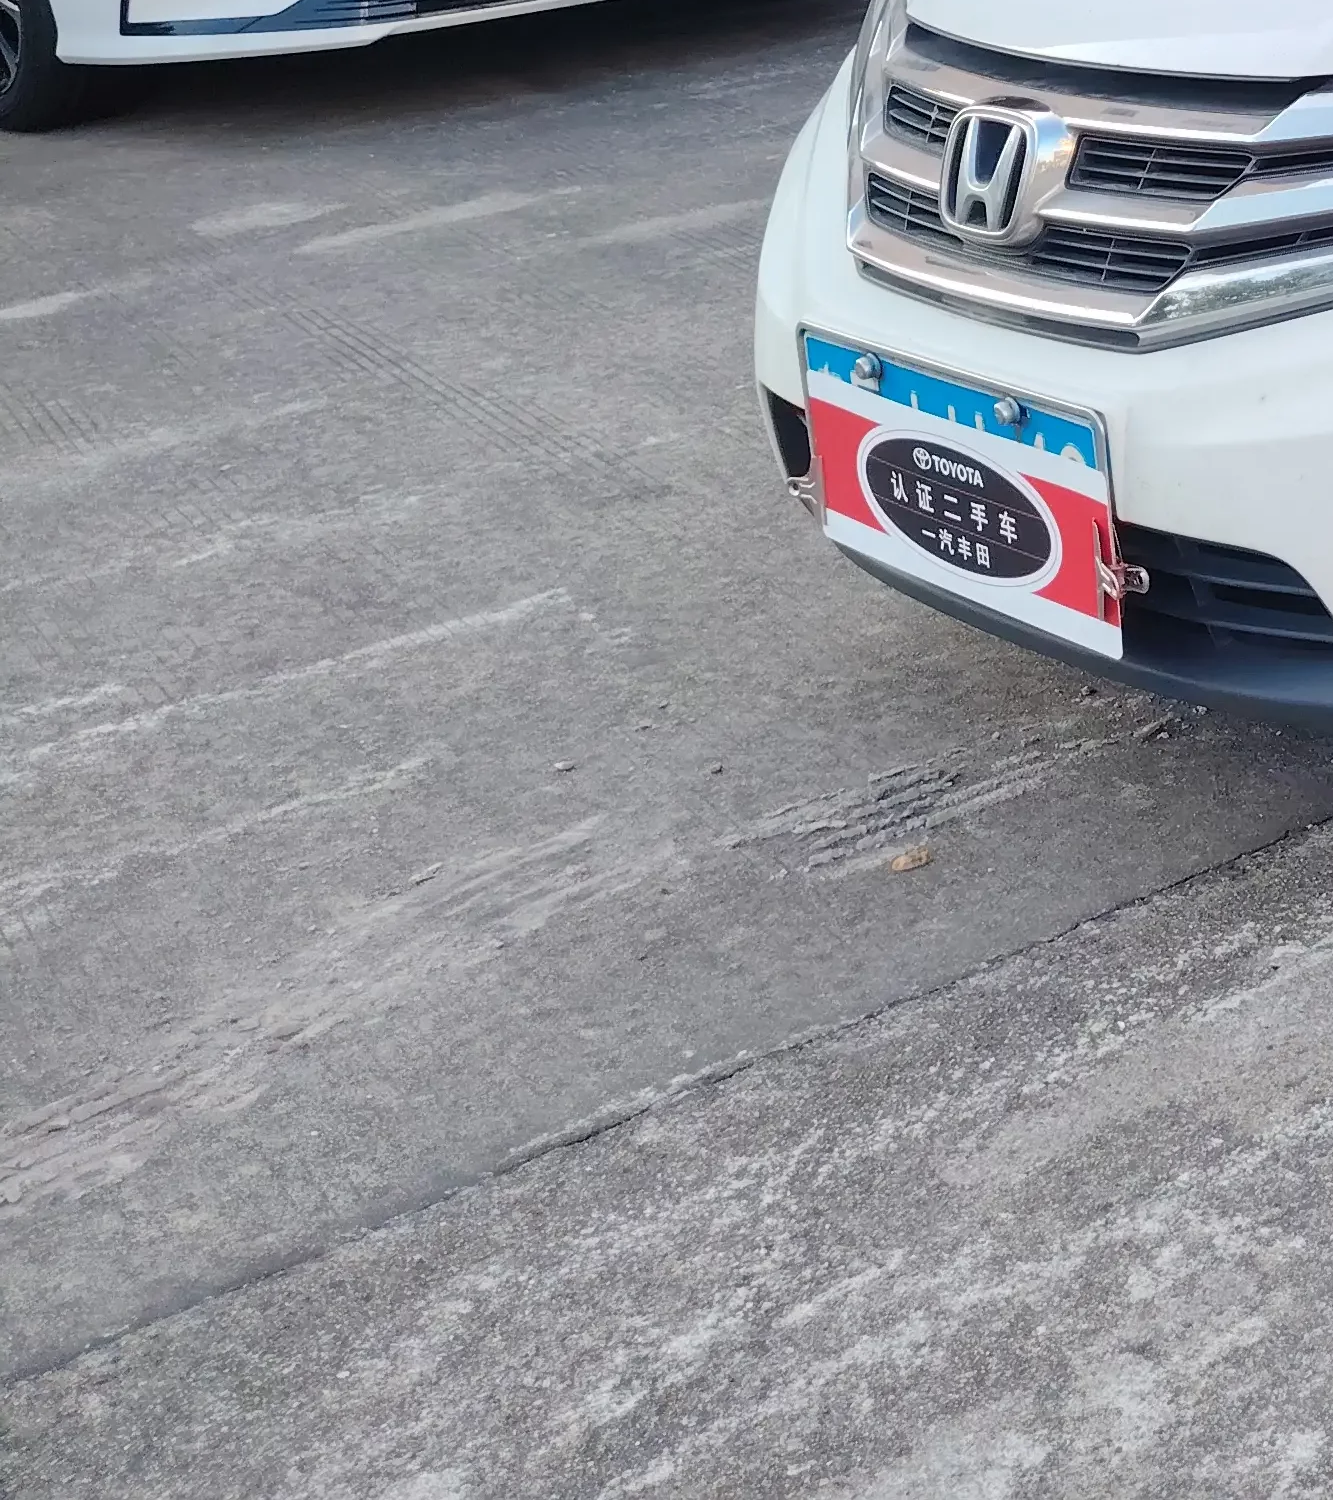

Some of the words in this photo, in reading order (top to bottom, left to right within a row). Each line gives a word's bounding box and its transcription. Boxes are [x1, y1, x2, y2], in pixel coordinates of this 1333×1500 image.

[931, 454, 985, 488] TOYOTA
[890, 470, 1018, 544] 认证二手车
[921, 528, 991, 569] 一汽丰田
